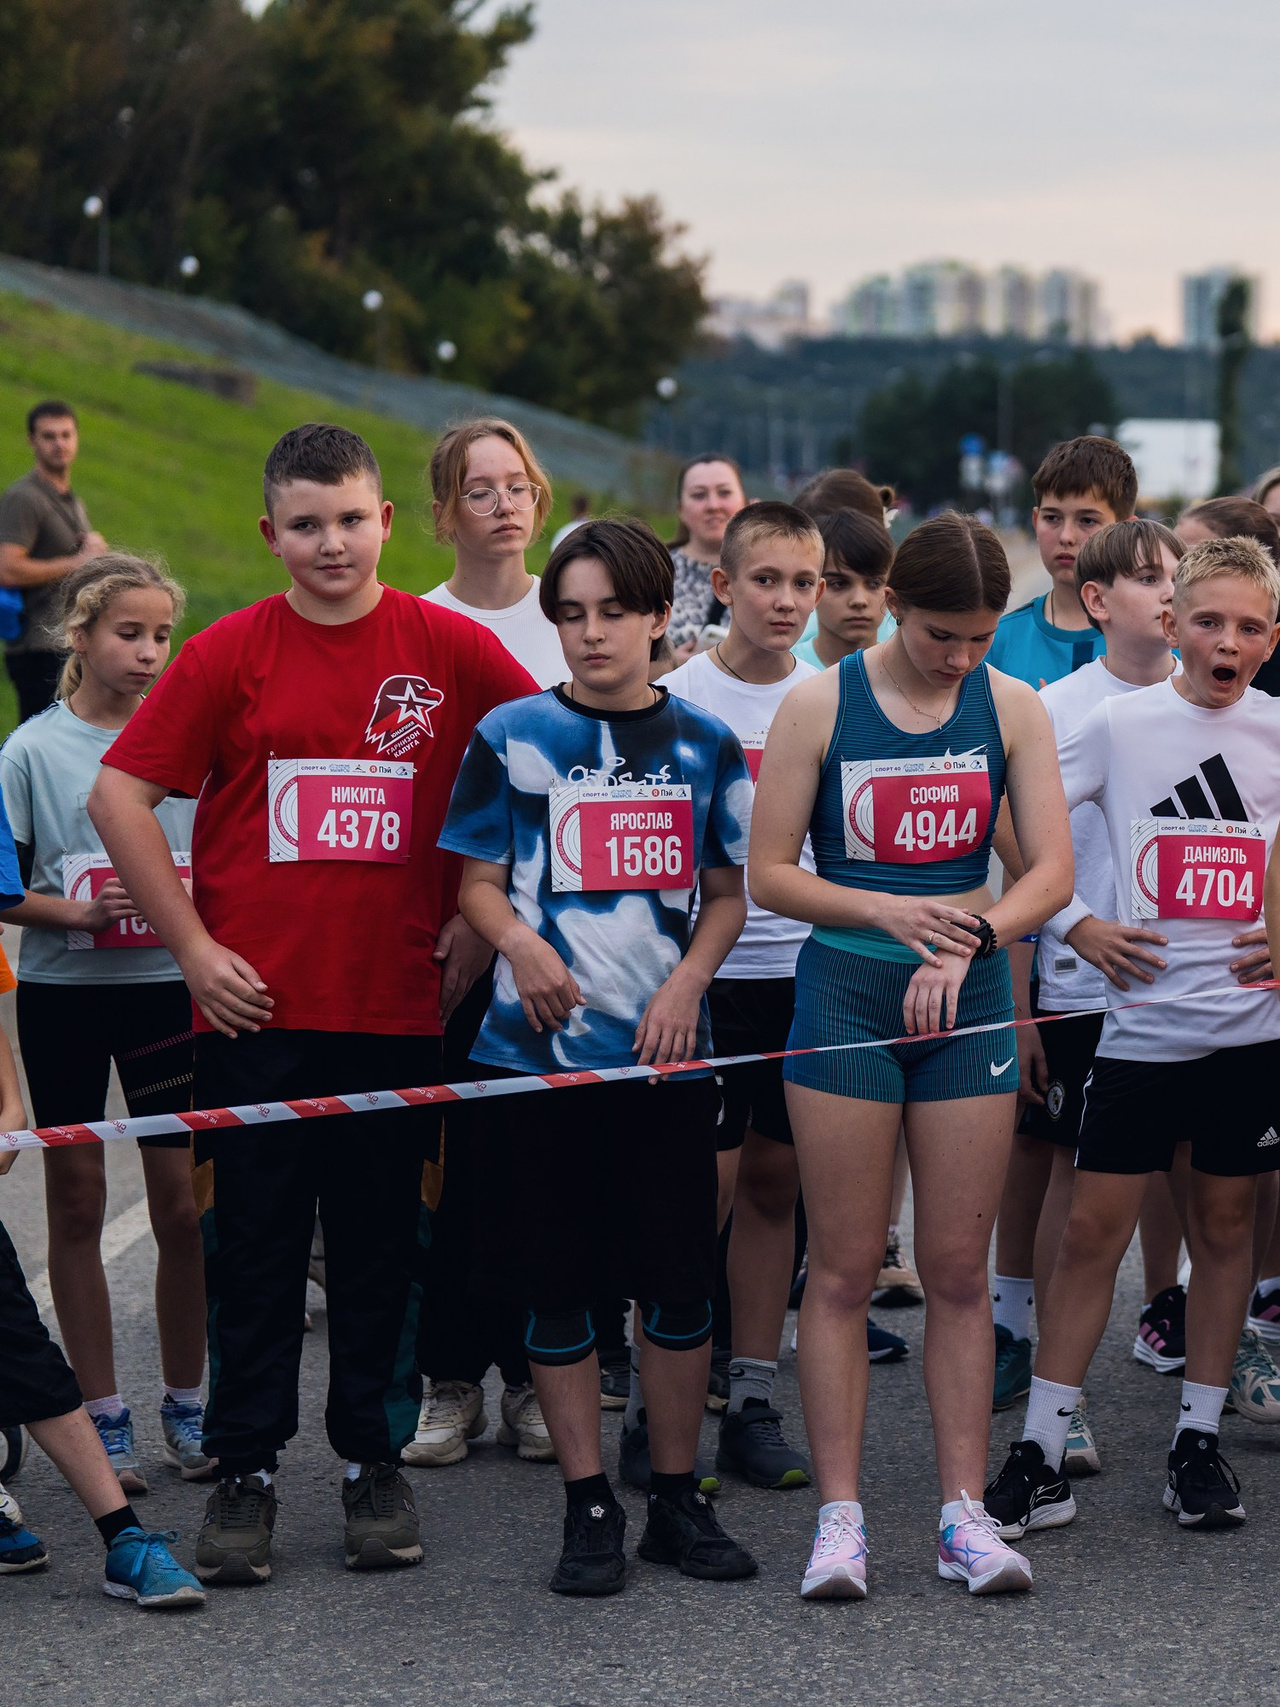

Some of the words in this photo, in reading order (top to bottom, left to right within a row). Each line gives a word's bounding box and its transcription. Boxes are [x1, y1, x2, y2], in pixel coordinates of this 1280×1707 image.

[391, 720, 416, 738] ЮНАРМИЯ
[386, 730, 421, 755] ГАРНИЗОН
[393, 739, 421, 758] КАЛУГА
[331, 786, 386, 805] НИКИТА
[909, 784, 960, 805] СОФИЯ
[317, 808, 401, 851] 4378
[610, 812, 673, 831] ЯРОСЛАВ
[893, 807, 978, 852] 4944
[605, 835, 682, 877] 1586
[1182, 846, 1247, 865] ДАНИЭЛЬ
[1175, 868, 1255, 909] 4704
[1256, 1136, 1280, 1148] adidas
